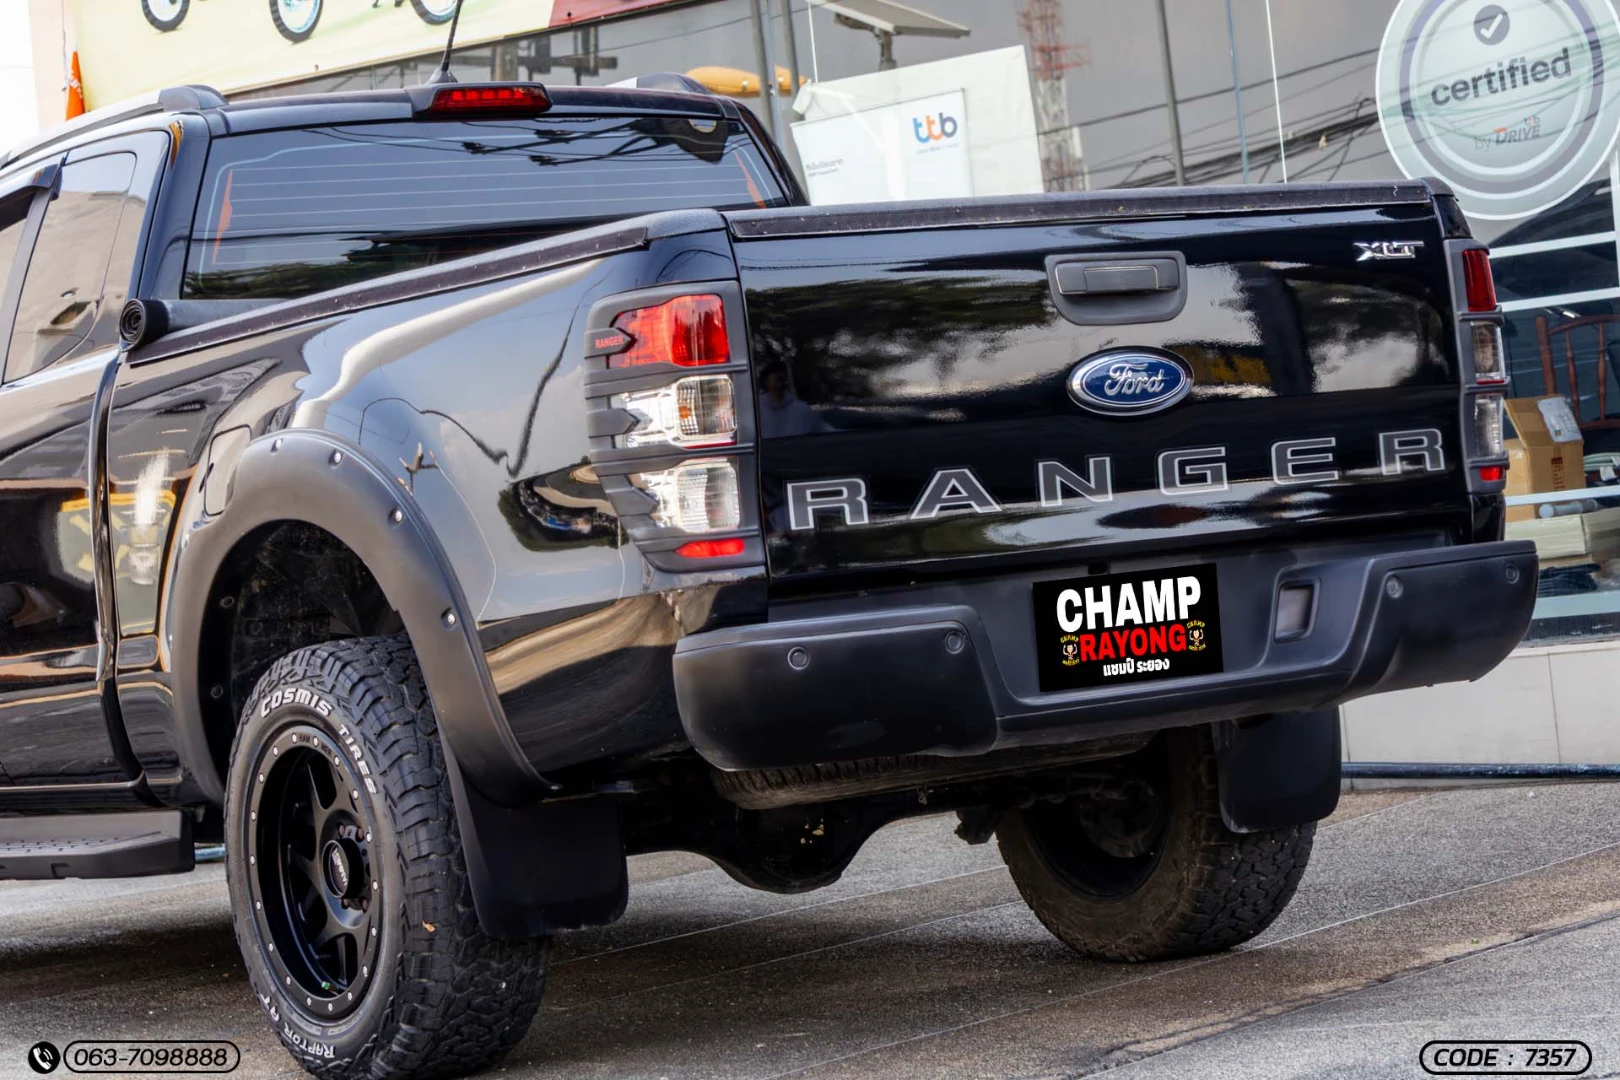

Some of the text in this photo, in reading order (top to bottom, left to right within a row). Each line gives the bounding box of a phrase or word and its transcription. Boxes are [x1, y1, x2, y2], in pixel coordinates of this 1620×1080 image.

[1431, 47, 1571, 106] certified
[912, 112, 958, 144] ttb
[1494, 125, 1541, 144] DRIVE
[1353, 240, 1424, 262] XLT
[595, 335, 624, 349] RANGER
[1104, 363, 1165, 396] Ford
[786, 428, 1447, 531] RANGER
[261, 687, 378, 794] COSMIS TIRES
[284, 1021, 335, 1058] RAPTOR
